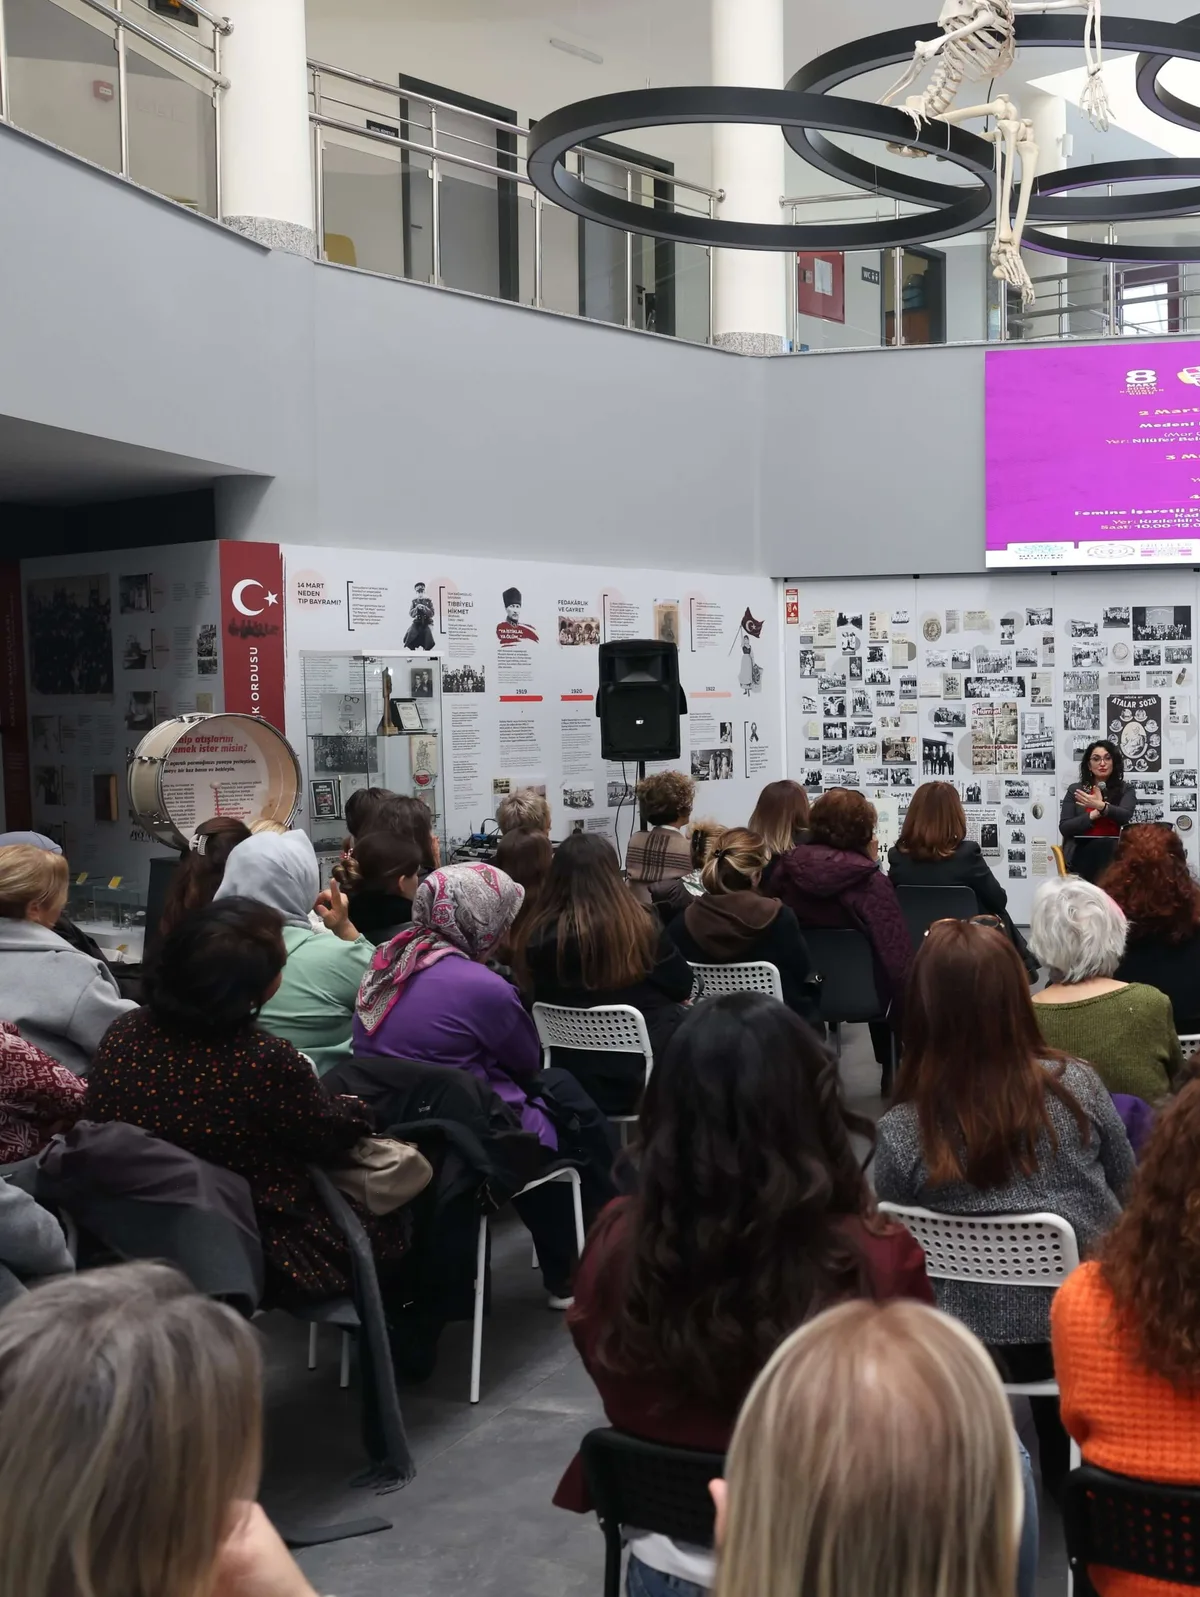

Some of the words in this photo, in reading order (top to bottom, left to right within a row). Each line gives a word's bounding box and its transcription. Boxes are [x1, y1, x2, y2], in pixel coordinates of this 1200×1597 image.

[863, 271, 871, 279] WC
[1125, 369, 1157, 384] 8
[1154, 407, 1200, 415] Mart
[1139, 421, 1195, 429] Medeni
[249, 646, 260, 701] ORDUSU
[1111, 697, 1137, 709] ATALAR
[178, 735, 193, 745] alp
[172, 744, 197, 754] emek
[199, 744, 219, 753] ister
[220, 744, 248, 753] misin?
